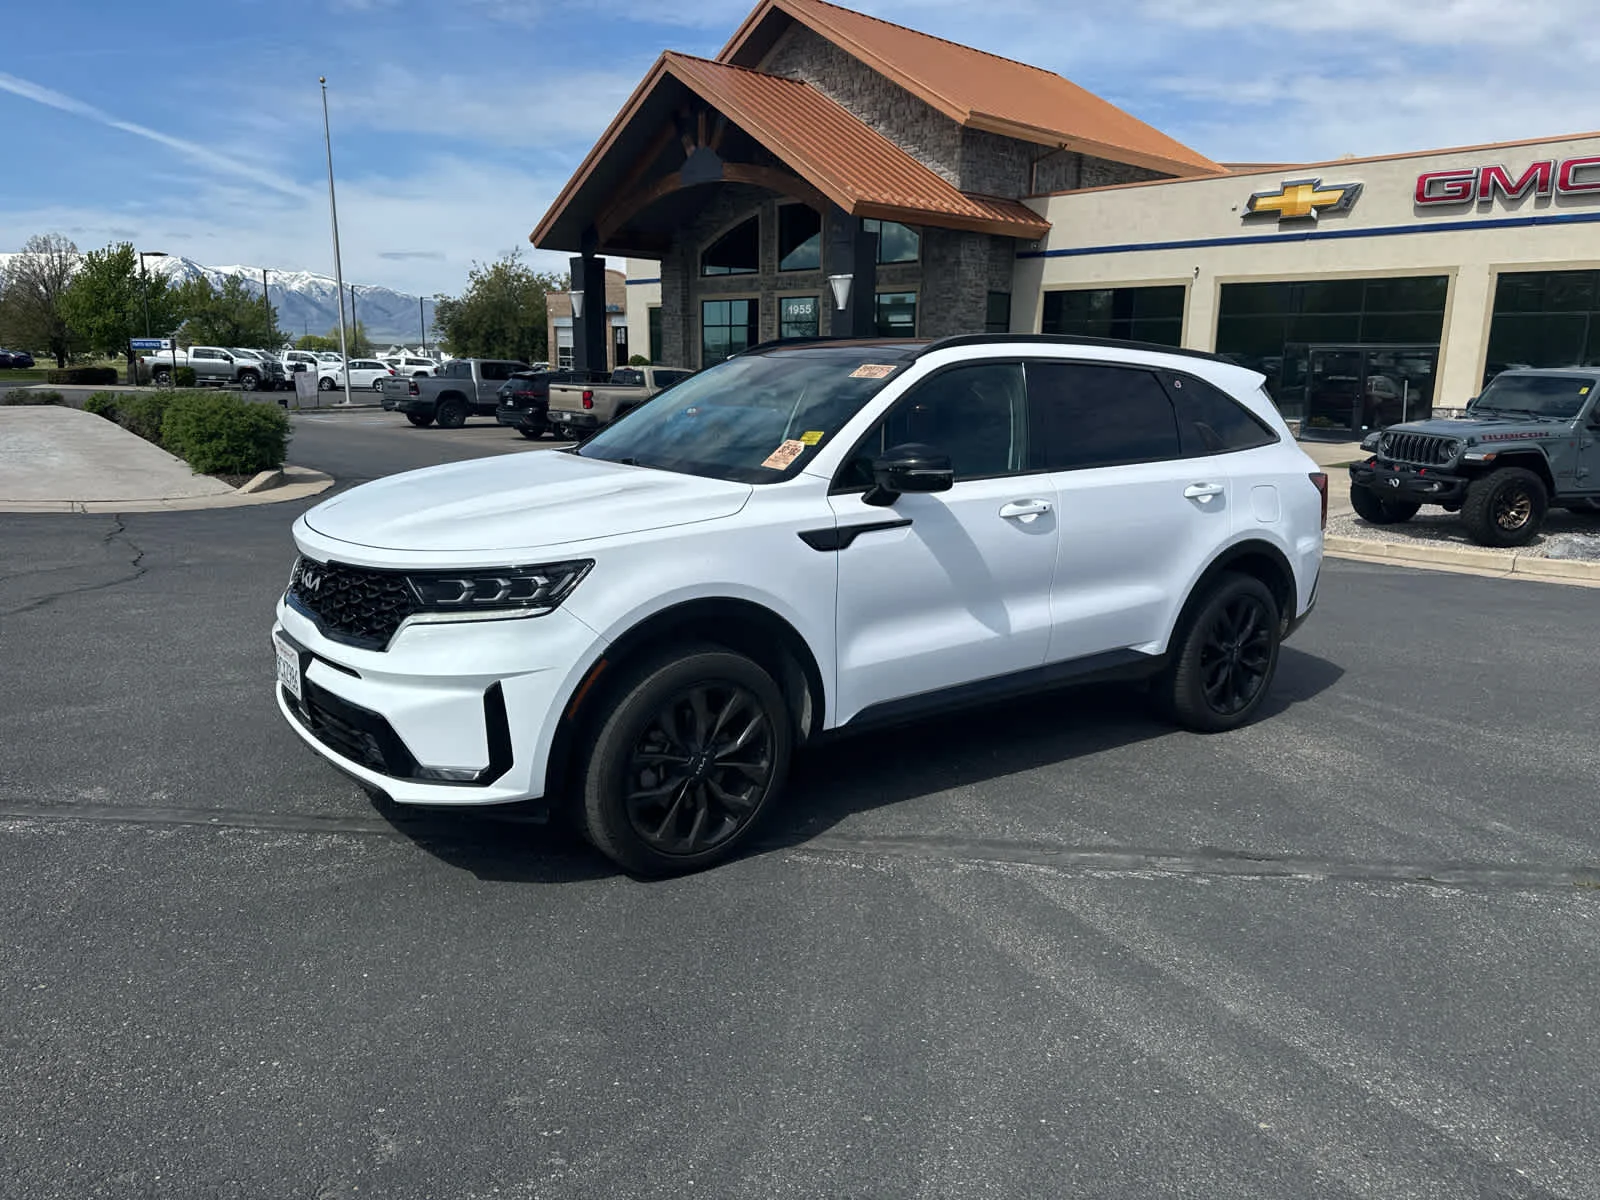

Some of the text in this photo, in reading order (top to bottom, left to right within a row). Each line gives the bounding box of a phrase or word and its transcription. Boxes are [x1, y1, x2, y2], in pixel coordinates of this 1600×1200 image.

[1415, 157, 1600, 206] GMC
[788, 304, 812, 315] 1955
[1482, 432, 1549, 441] RUBICON
